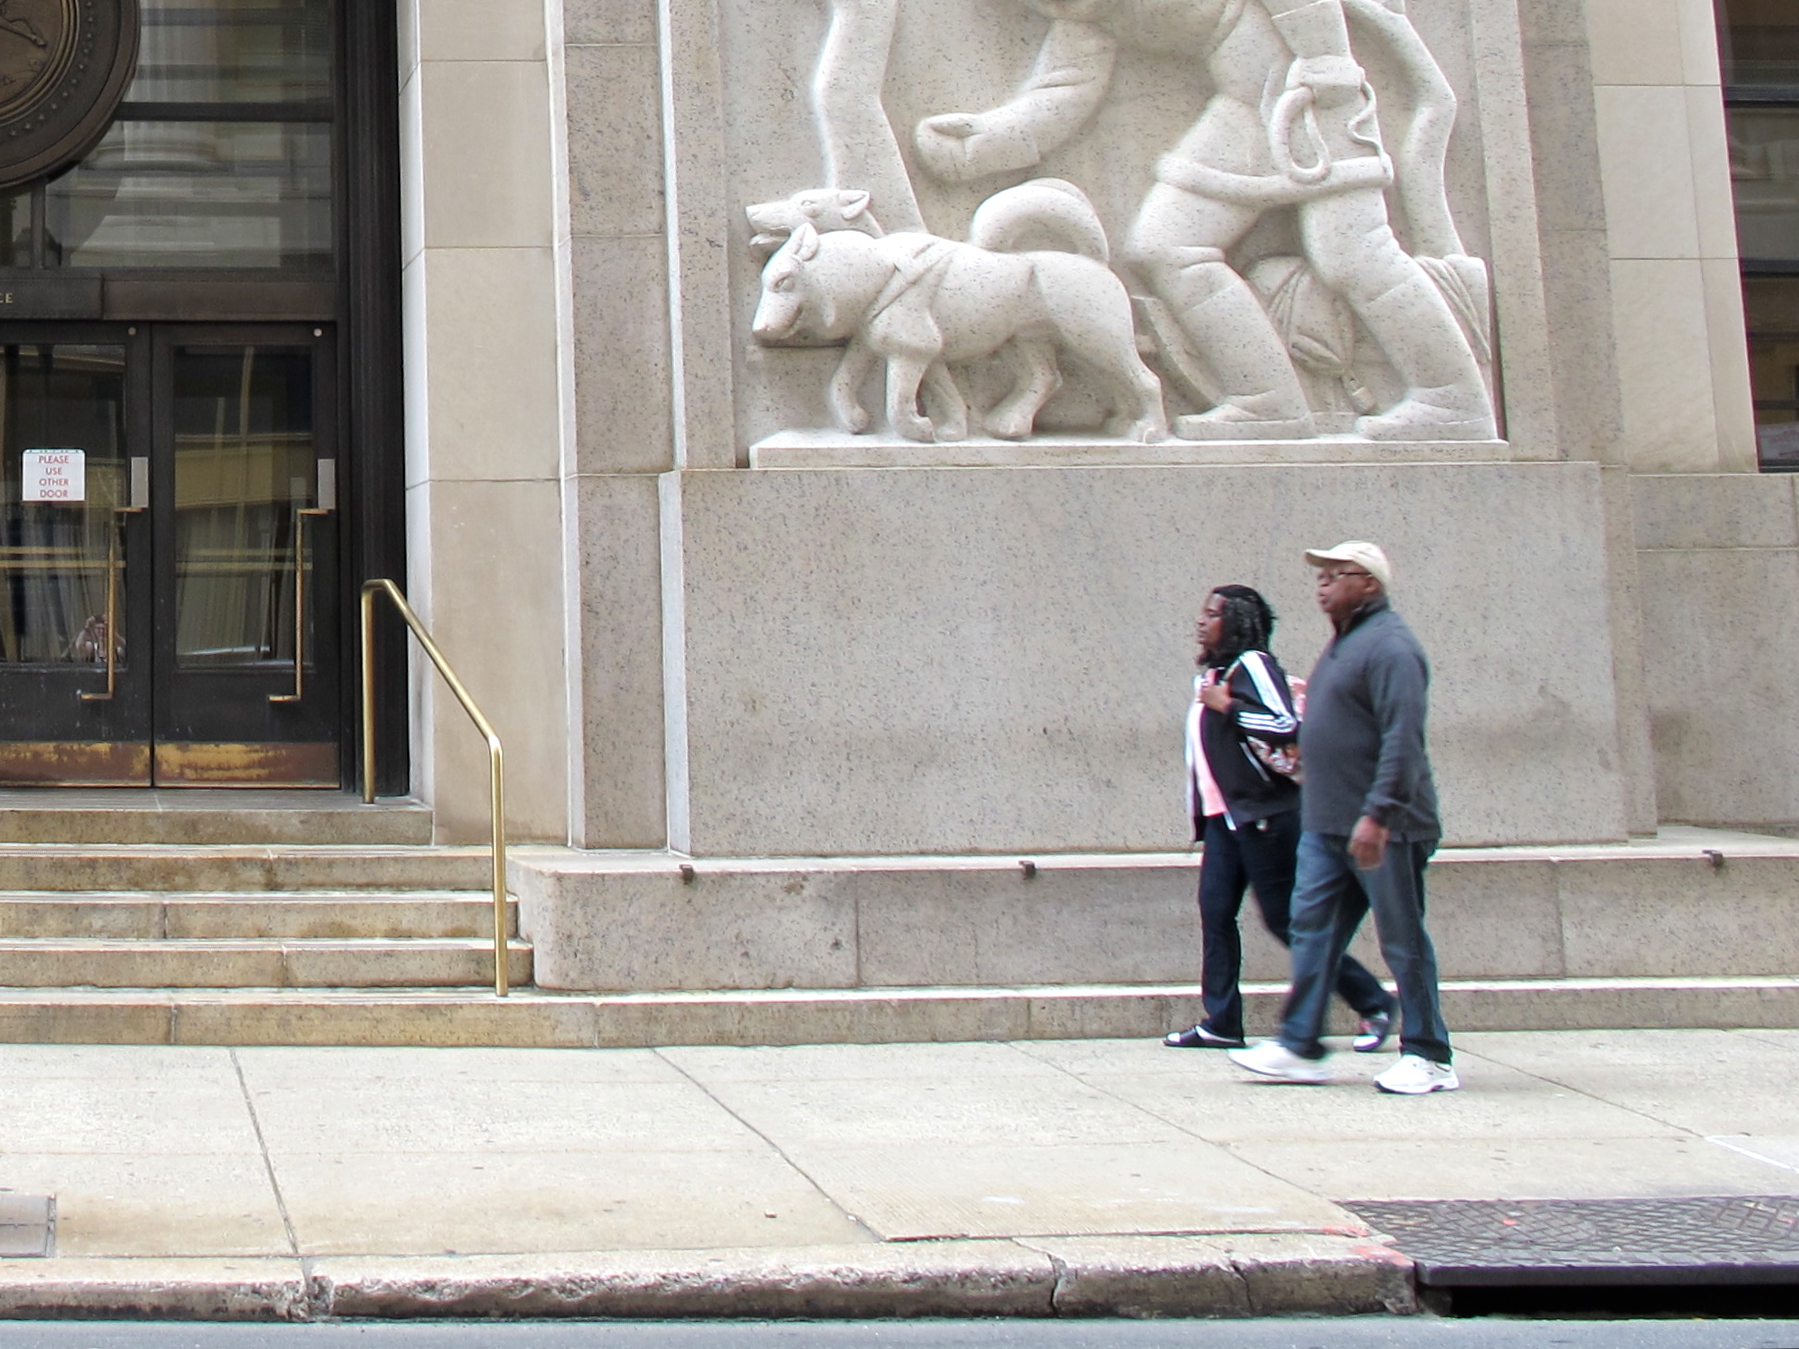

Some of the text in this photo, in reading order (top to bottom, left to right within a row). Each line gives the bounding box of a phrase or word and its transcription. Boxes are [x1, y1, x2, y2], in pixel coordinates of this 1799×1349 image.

[38, 455, 69, 464] PLEASE
[45, 467, 62, 475] USE
[39, 478, 69, 487] OTHER
[40, 489, 68, 498] DOOR
